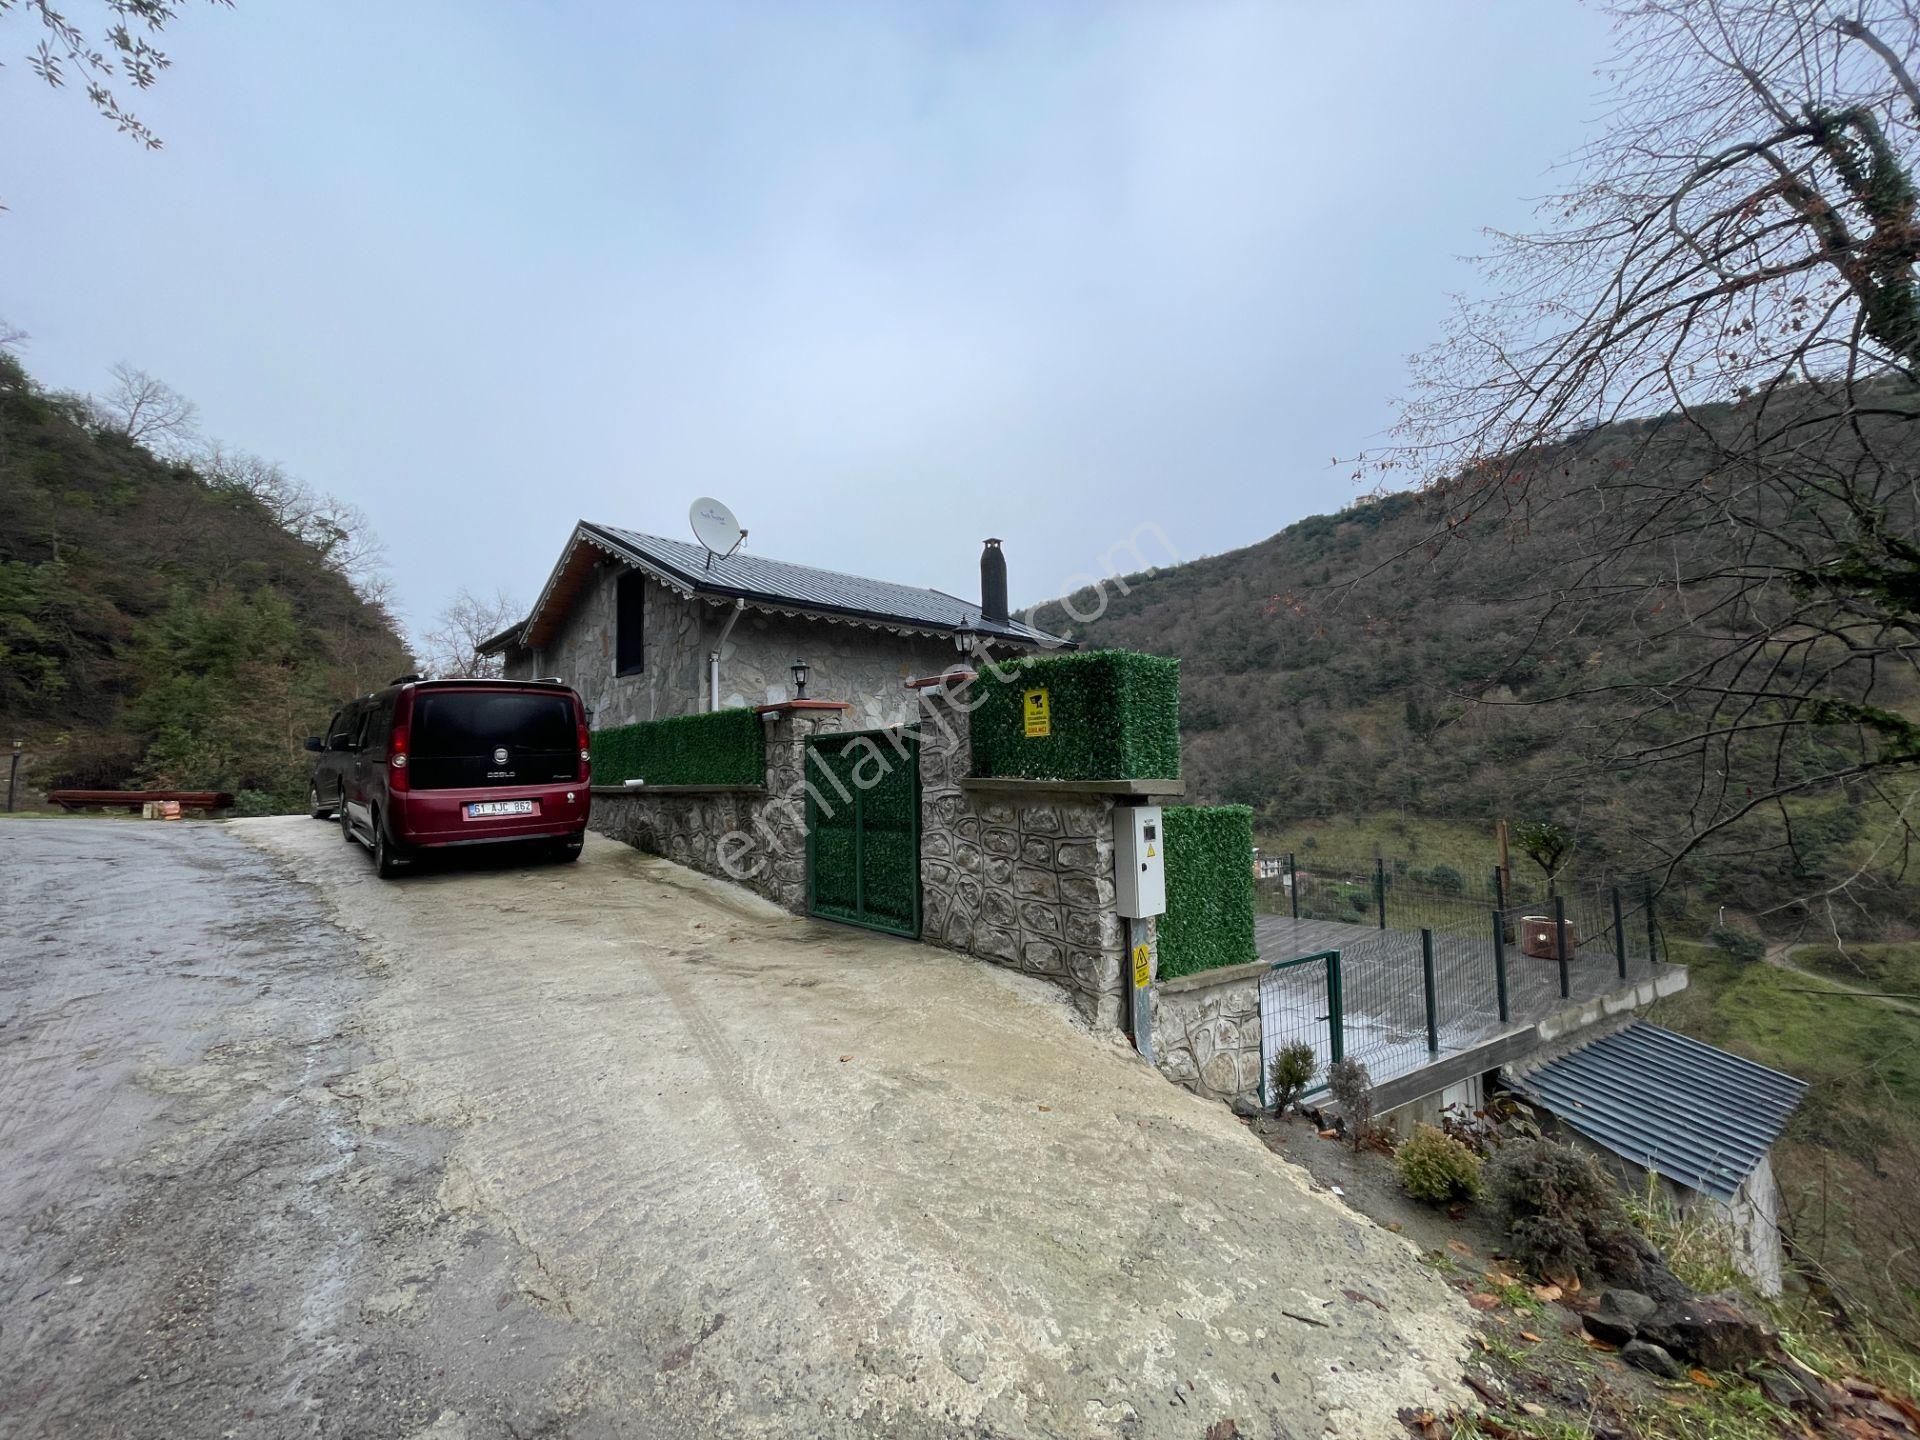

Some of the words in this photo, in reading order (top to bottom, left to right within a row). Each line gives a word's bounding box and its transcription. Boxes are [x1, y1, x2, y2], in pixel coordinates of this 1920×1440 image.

[474, 804, 485, 813] 61
[491, 802, 509, 812] AJC
[514, 801, 531, 811] 862
